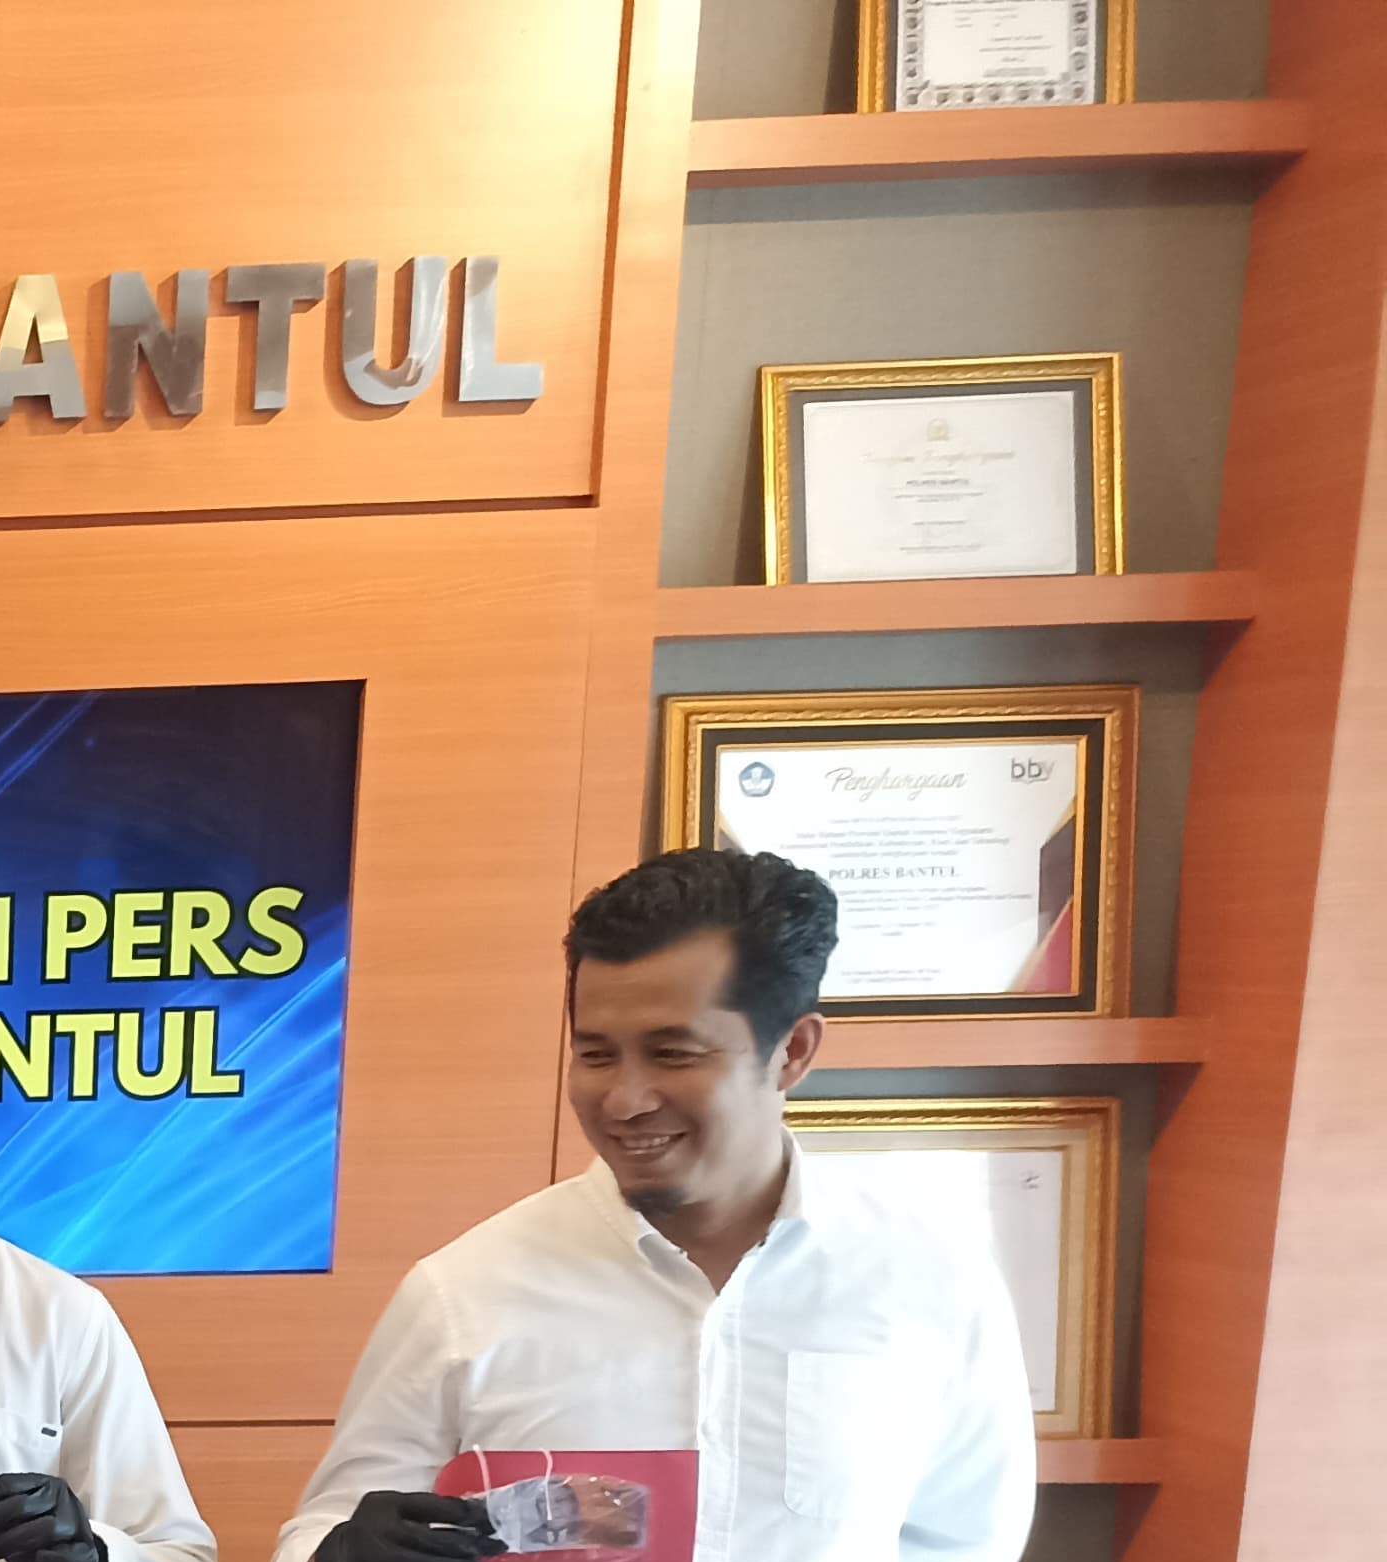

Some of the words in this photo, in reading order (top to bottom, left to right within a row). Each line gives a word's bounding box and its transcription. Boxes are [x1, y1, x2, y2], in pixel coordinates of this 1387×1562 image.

[824, 766, 966, 803] Penghargaan
[828, 867, 891, 881] POLRES
[895, 865, 959, 879] BANTUL
[45, 886, 305, 980] PERS
